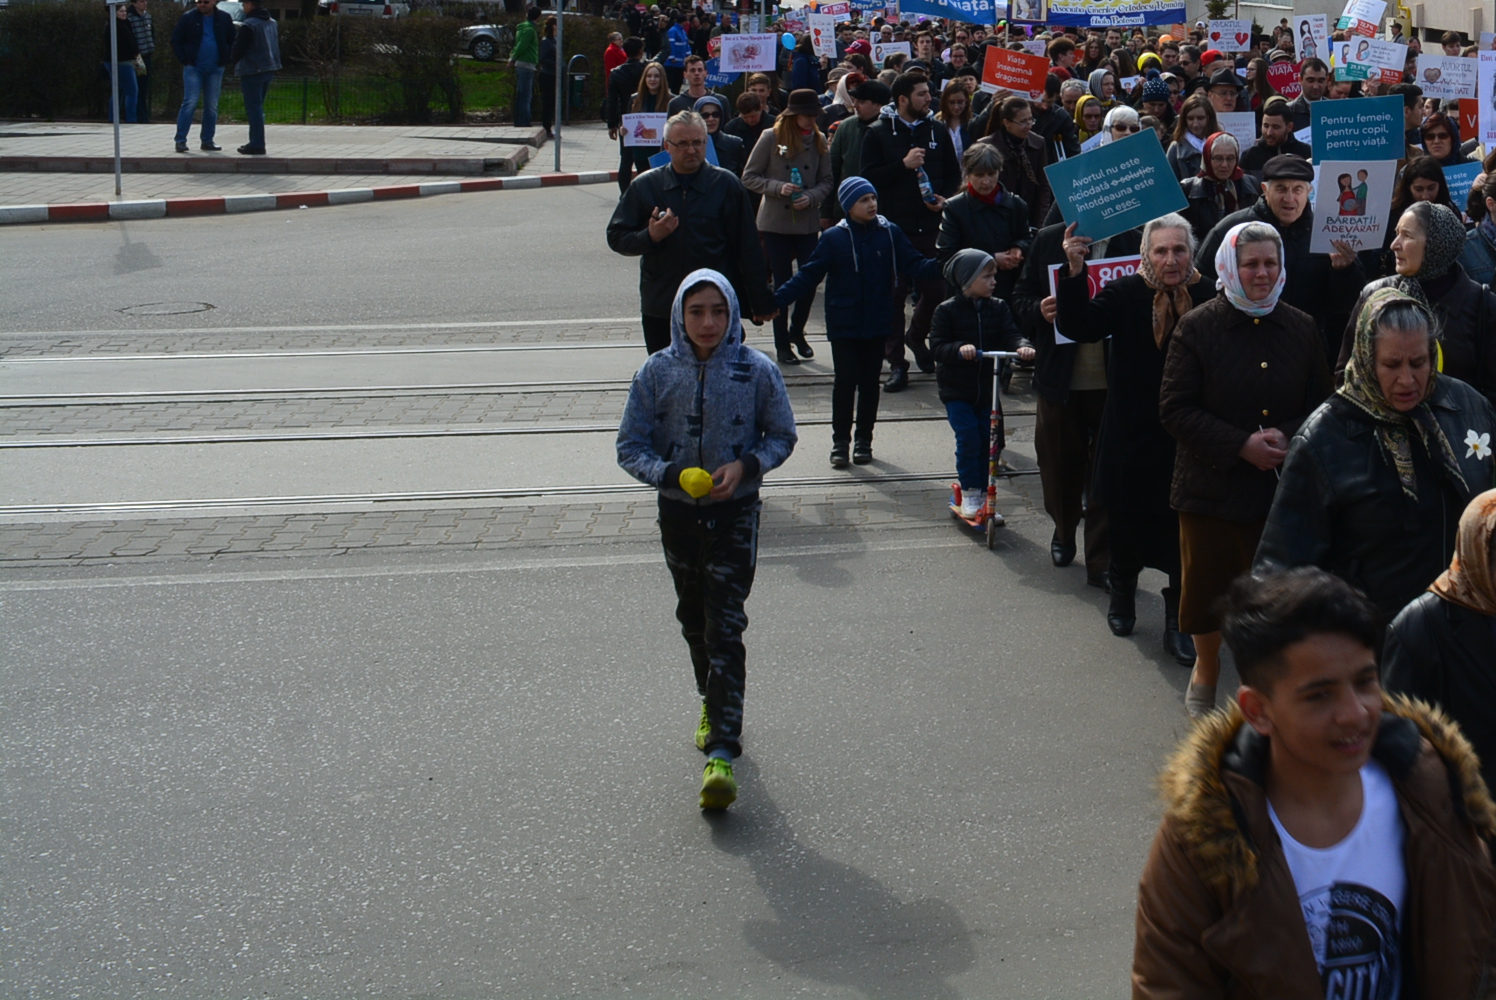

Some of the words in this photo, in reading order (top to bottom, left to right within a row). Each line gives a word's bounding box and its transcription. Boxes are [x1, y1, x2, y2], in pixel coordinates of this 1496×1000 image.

[996, 61, 1033, 76] înseamnă
[995, 71, 1031, 85] dragoste.
[1320, 115, 1354, 125] Pentru
[1356, 112, 1394, 124] femeie,
[1325, 128, 1359, 139] pentru
[1362, 124, 1389, 136] copil,
[1326, 139, 1360, 151] pentru
[1362, 135, 1389, 148] viață.
[1072, 168, 1105, 189] Avortul
[1105, 165, 1119, 175] nu
[1119, 157, 1141, 170] este
[1068, 181, 1110, 203] niciodată
[1075, 187, 1133, 213] întotdeauna
[1133, 177, 1155, 191] este
[1101, 207, 1114, 218] un
